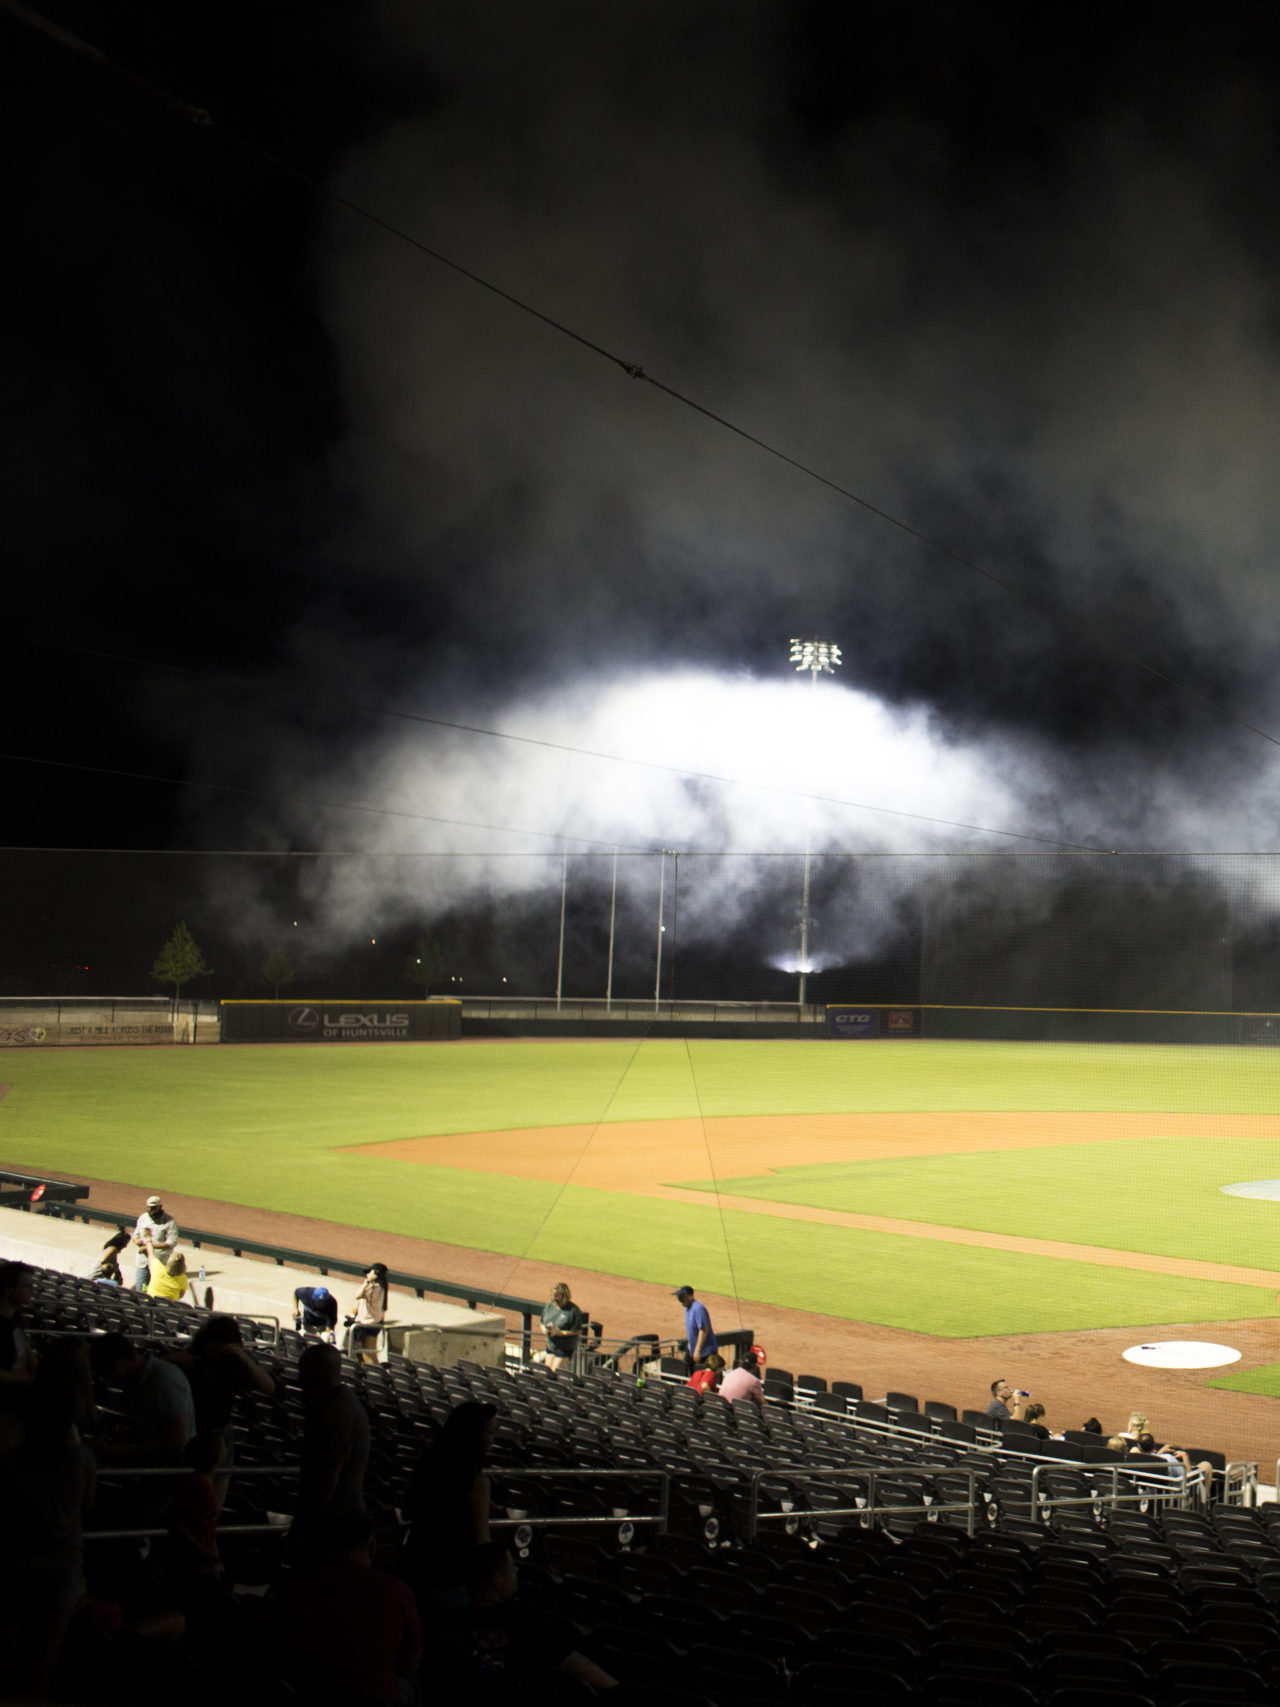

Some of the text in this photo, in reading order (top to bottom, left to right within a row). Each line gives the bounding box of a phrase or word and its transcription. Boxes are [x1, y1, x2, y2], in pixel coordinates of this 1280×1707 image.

[323, 1013, 409, 1028] LEXUS
[835, 1014, 871, 1023] CTG
[323, 1028, 408, 1037] OF HUNTSVILLE
